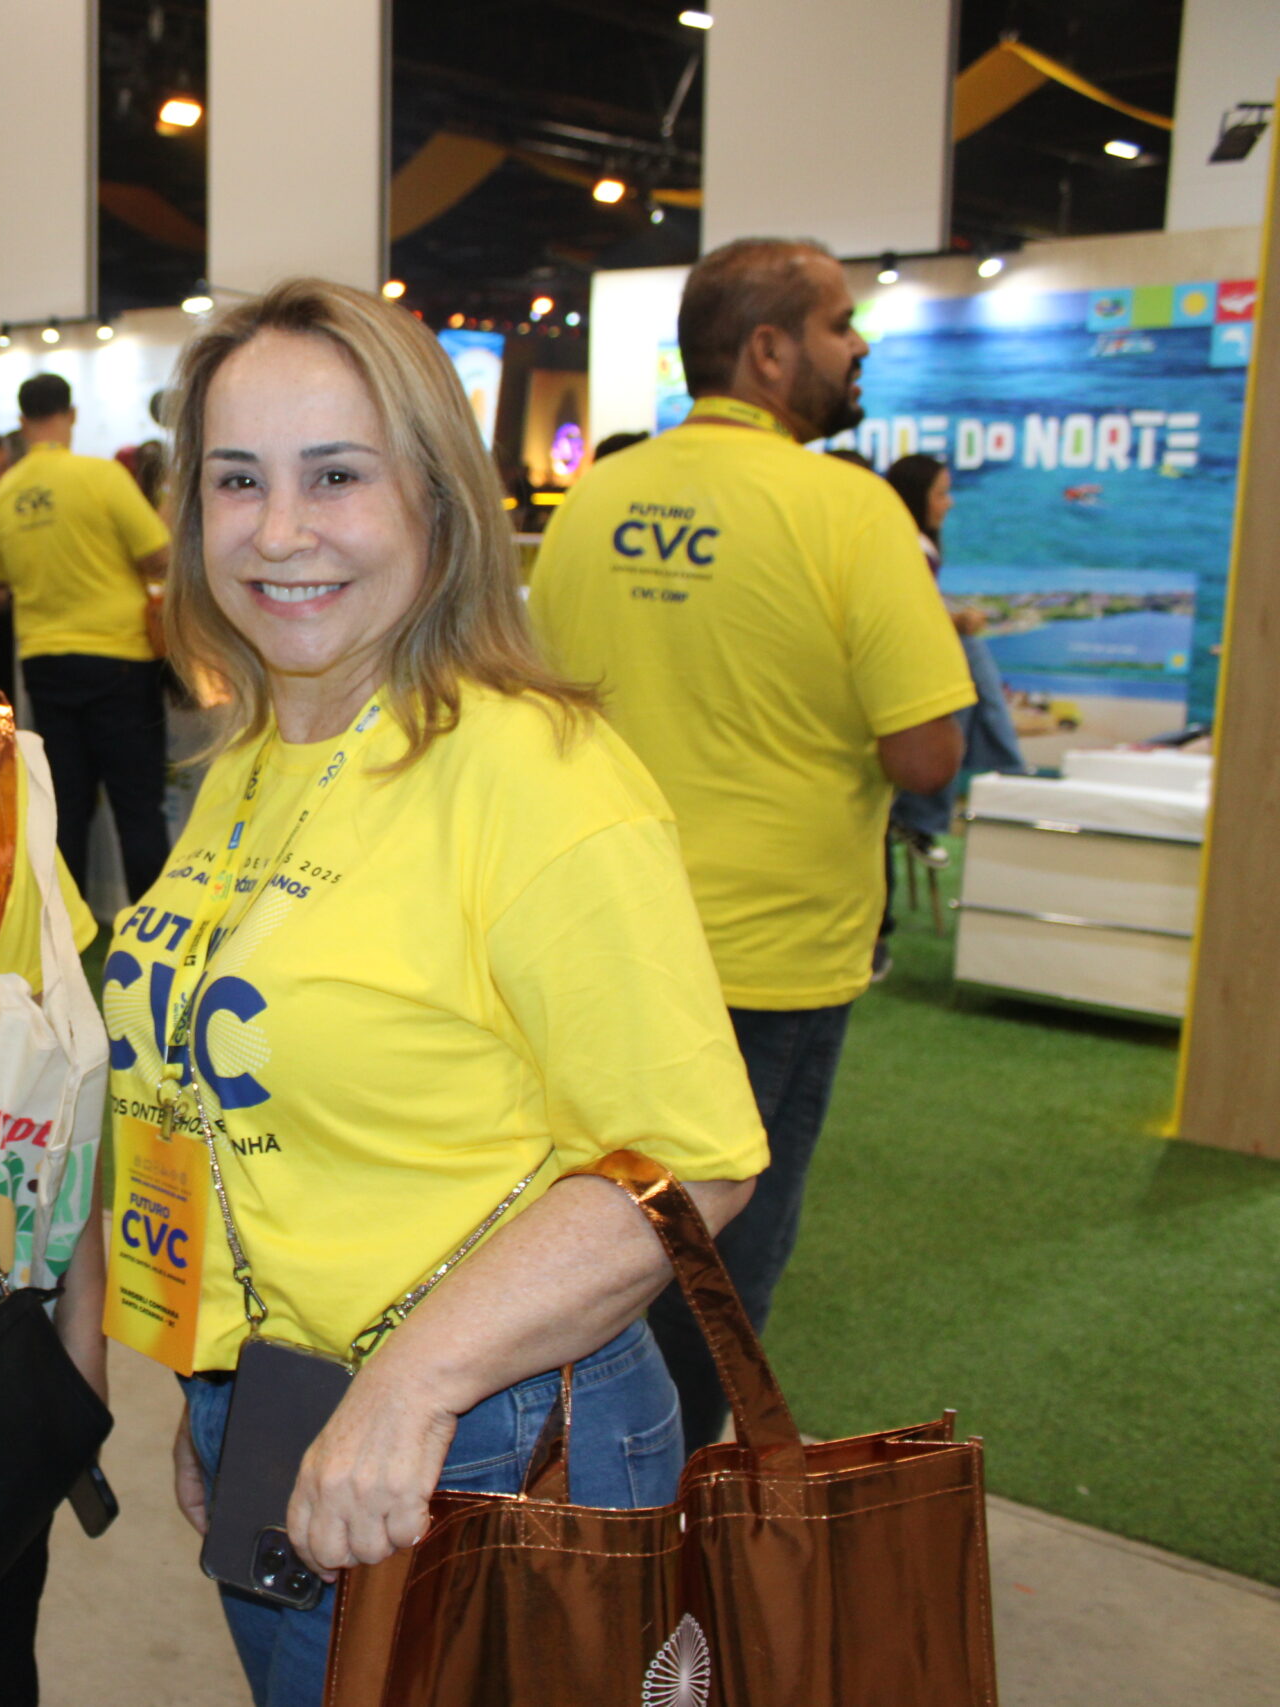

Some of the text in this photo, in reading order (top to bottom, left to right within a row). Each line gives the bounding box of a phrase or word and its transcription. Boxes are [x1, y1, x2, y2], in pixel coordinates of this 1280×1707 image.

[1023, 410, 1200, 471] NORTE
[613, 520, 720, 566] CVC
[299, 860, 343, 885] 2025
[231, 1133, 282, 1156] NHÃ
[130, 1191, 171, 1220] FUTURO
[122, 1208, 189, 1269] CVC
